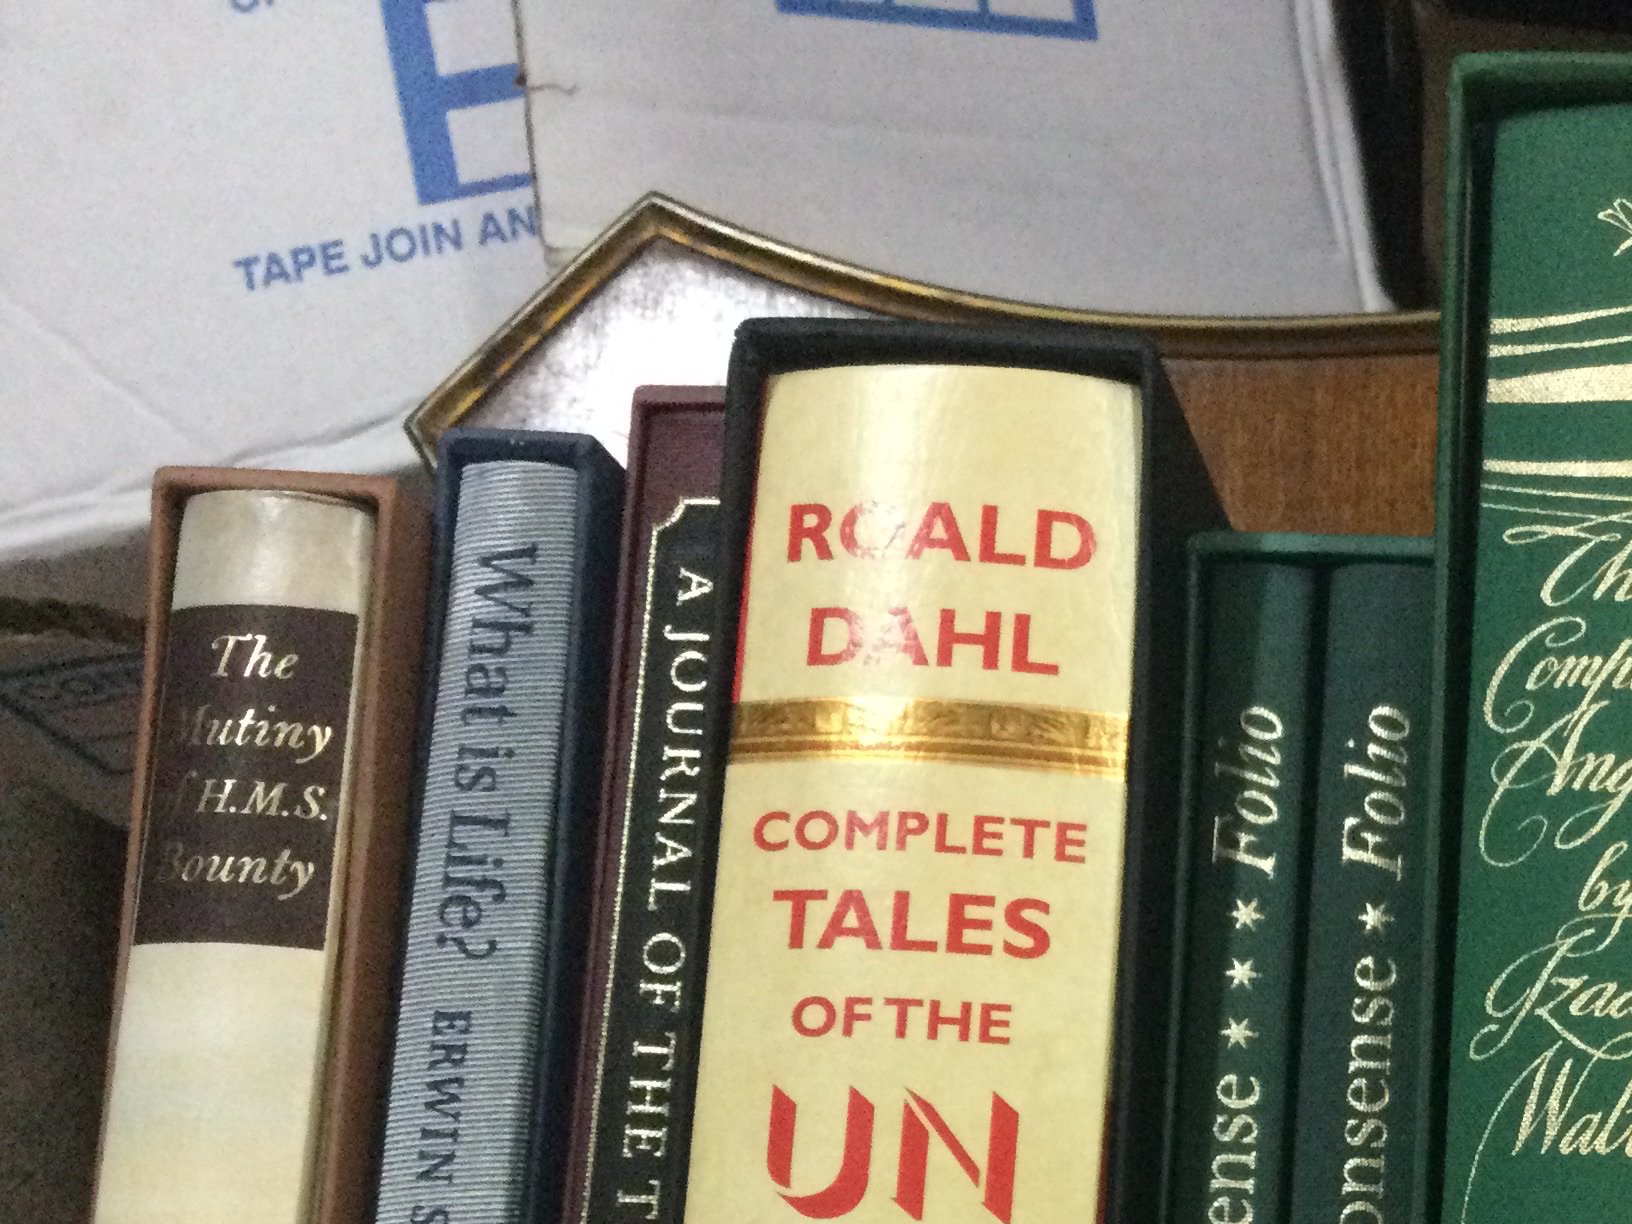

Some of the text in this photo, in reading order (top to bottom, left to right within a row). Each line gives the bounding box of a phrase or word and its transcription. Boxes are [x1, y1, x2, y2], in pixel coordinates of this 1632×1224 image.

[233, 239, 350, 291] TAPE
[360, 217, 463, 269] JOIN
[675, 566, 716, 607] A
[210, 632, 300, 681] The
[805, 606, 1061, 676] DAHL
[434, 541, 540, 962] What is Life?
[646, 623, 711, 912] JOURNAL
[194, 776, 329, 823] H.M.S.
[1211, 703, 1285, 881] Folio
[1340, 703, 1411, 882] Folio
[752, 809, 1089, 865] COMPLETE
[772, 888, 1052, 960] TALES
[638, 931, 688, 1014] OF
[791, 995, 1013, 1047] OF THE
[416, 1009, 474, 1185] ERWIN
[621, 1031, 678, 1159] THE
